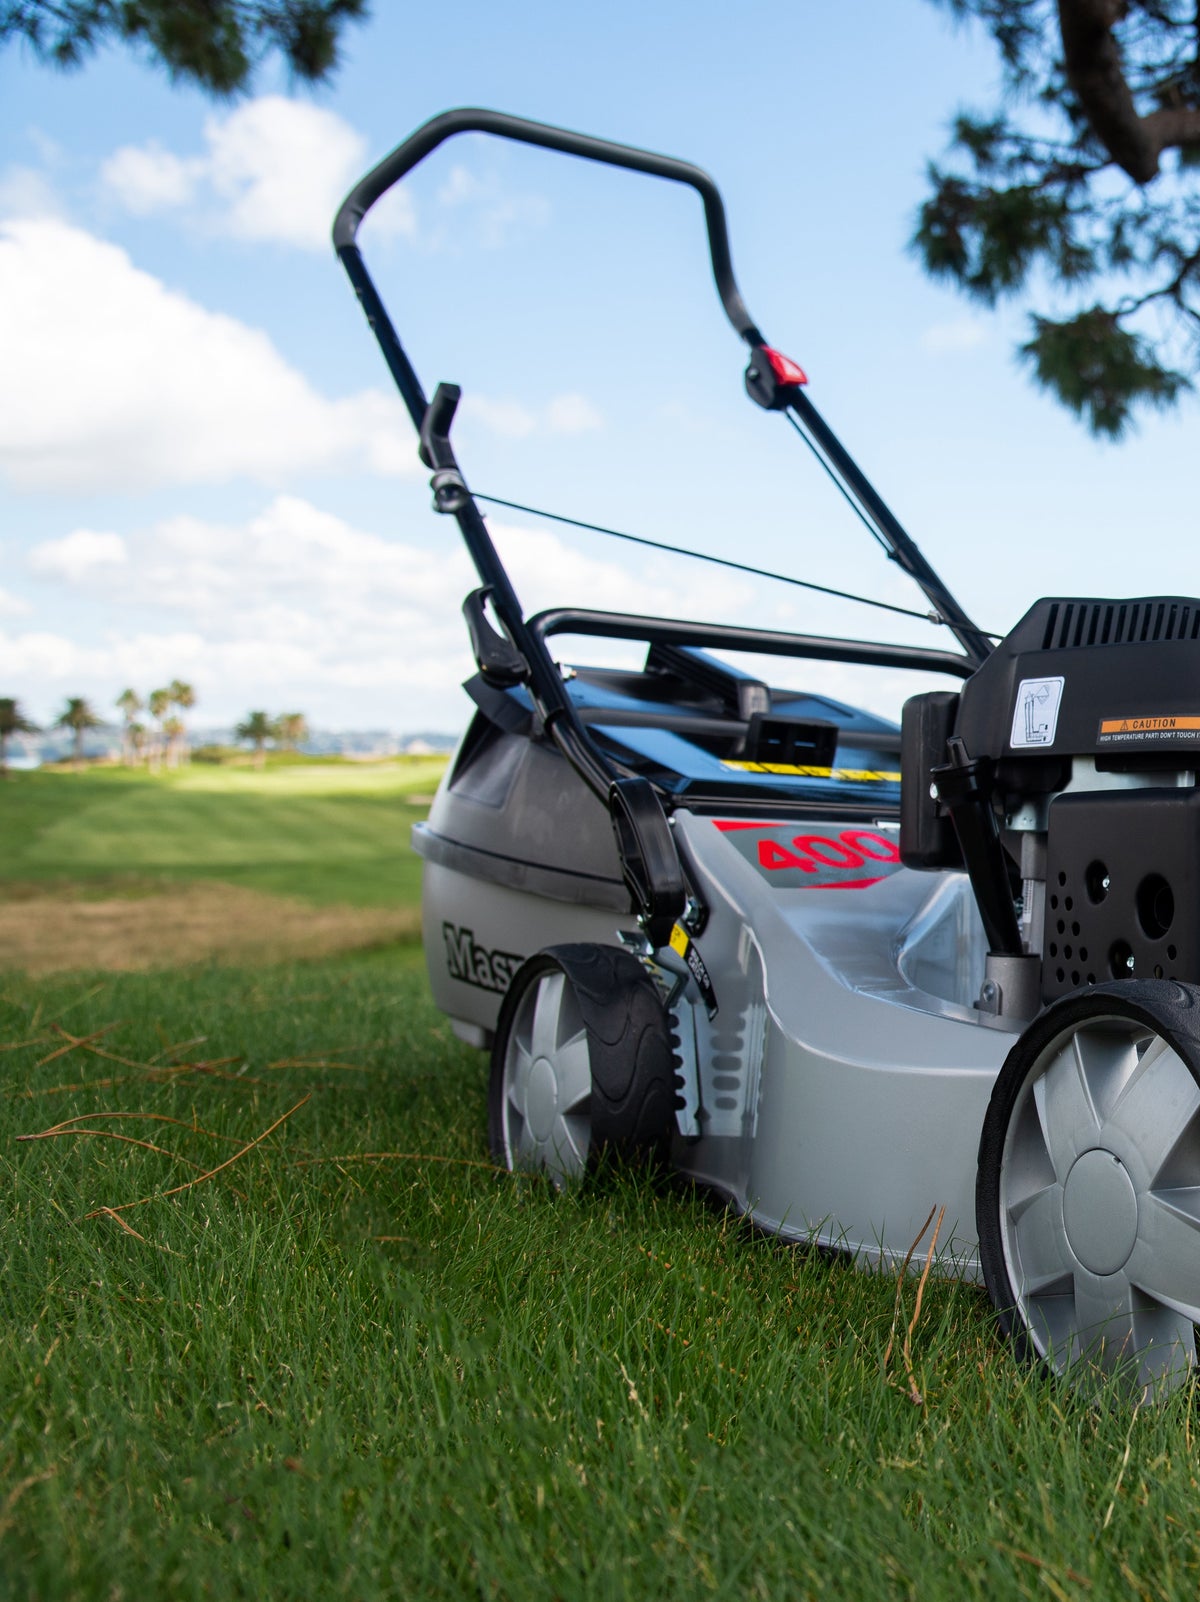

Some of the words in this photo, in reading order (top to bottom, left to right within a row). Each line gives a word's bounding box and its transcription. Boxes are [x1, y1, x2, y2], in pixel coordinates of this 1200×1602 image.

[1132, 718, 1177, 729] CAUTION
[1112, 733, 1144, 741] TEMPERATURE
[1176, 731, 1195, 739] TOUCH
[758, 829, 901, 873] 400
